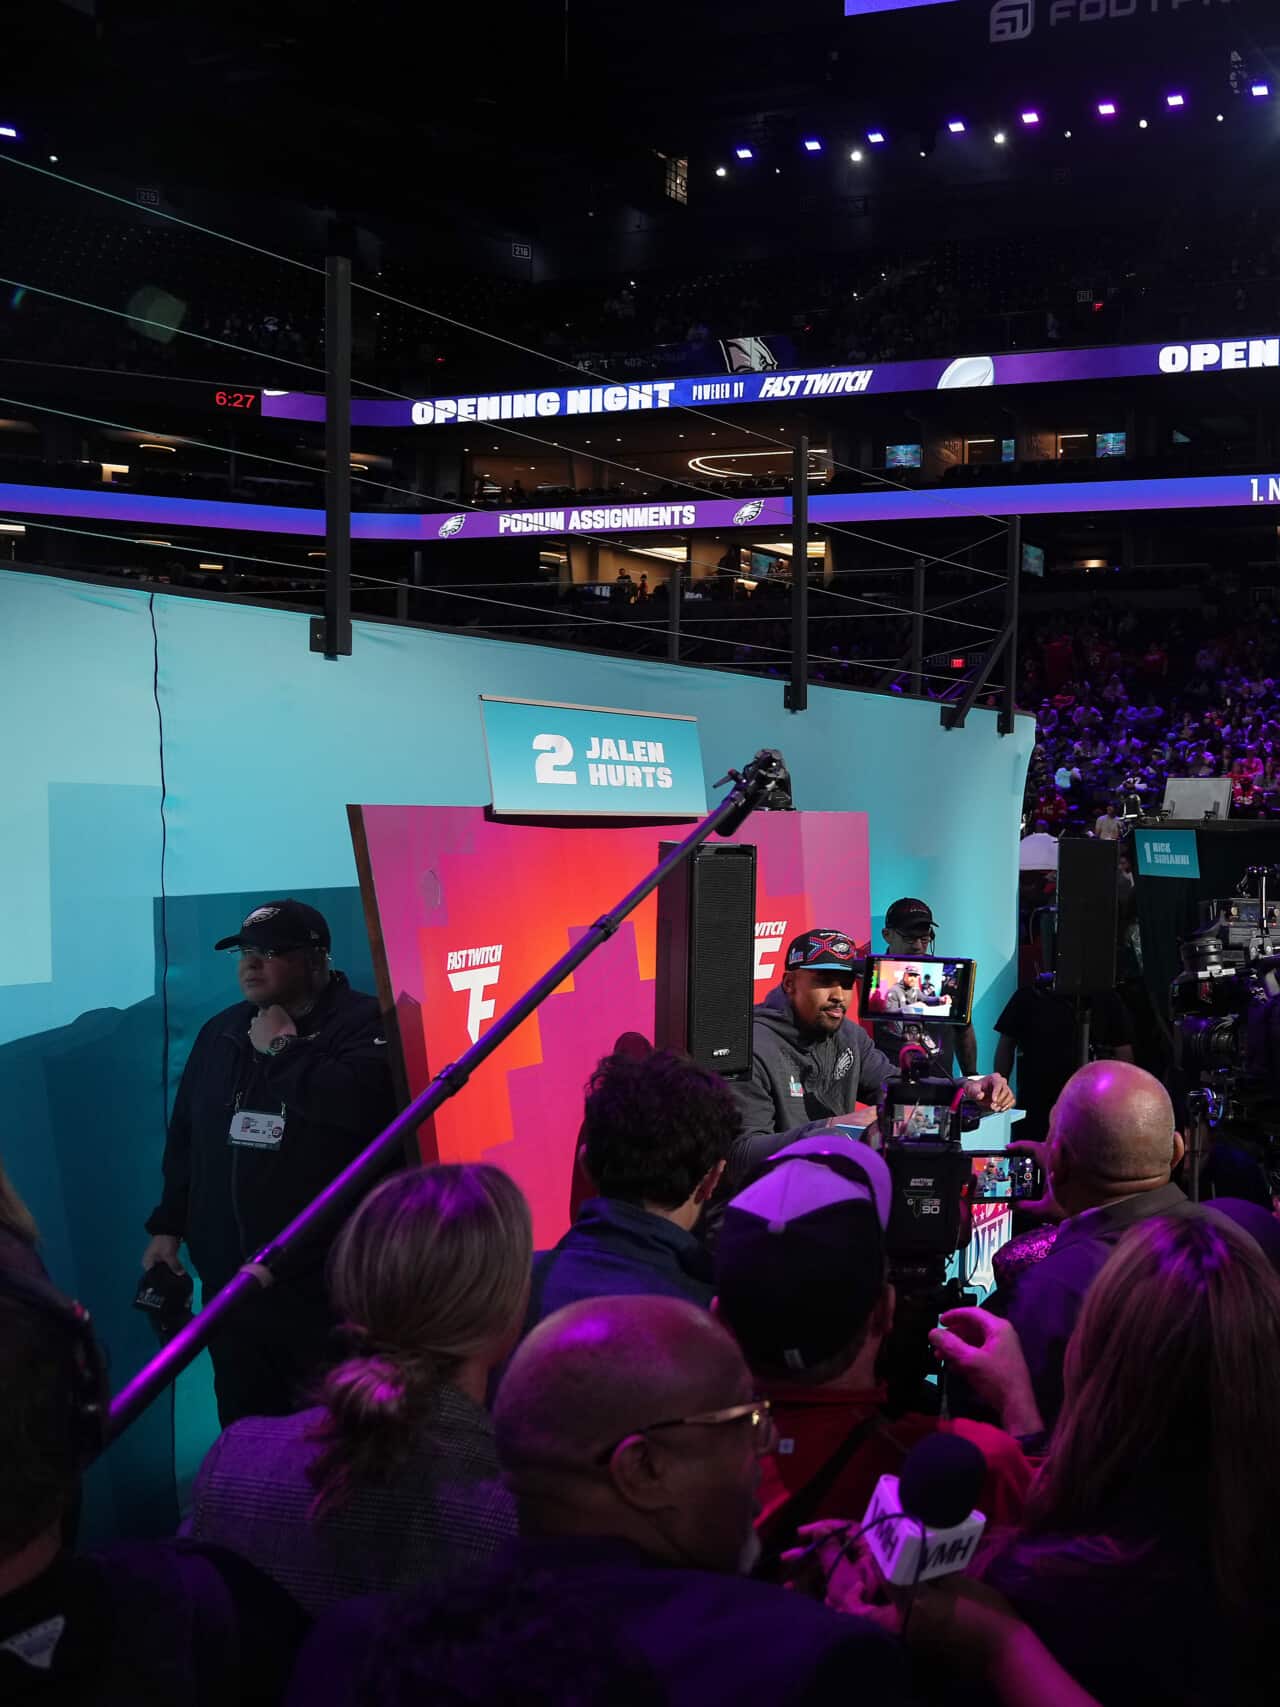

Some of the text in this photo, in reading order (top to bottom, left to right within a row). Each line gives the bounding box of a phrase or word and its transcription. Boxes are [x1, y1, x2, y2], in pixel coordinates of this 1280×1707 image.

[215, 391, 255, 409] 6:27
[411, 369, 874, 425] OPENING NIGHT POWERED BY FAST TWITCH
[1250, 477, 1264, 502] 1.
[498, 504, 696, 534] PODIUM ASSIGNMENTS
[532, 733, 665, 785] 2 JALEN
[587, 763, 674, 789] HURTS
[1144, 841, 1152, 865] 1
[447, 944, 503, 971] FAST TWITCH
